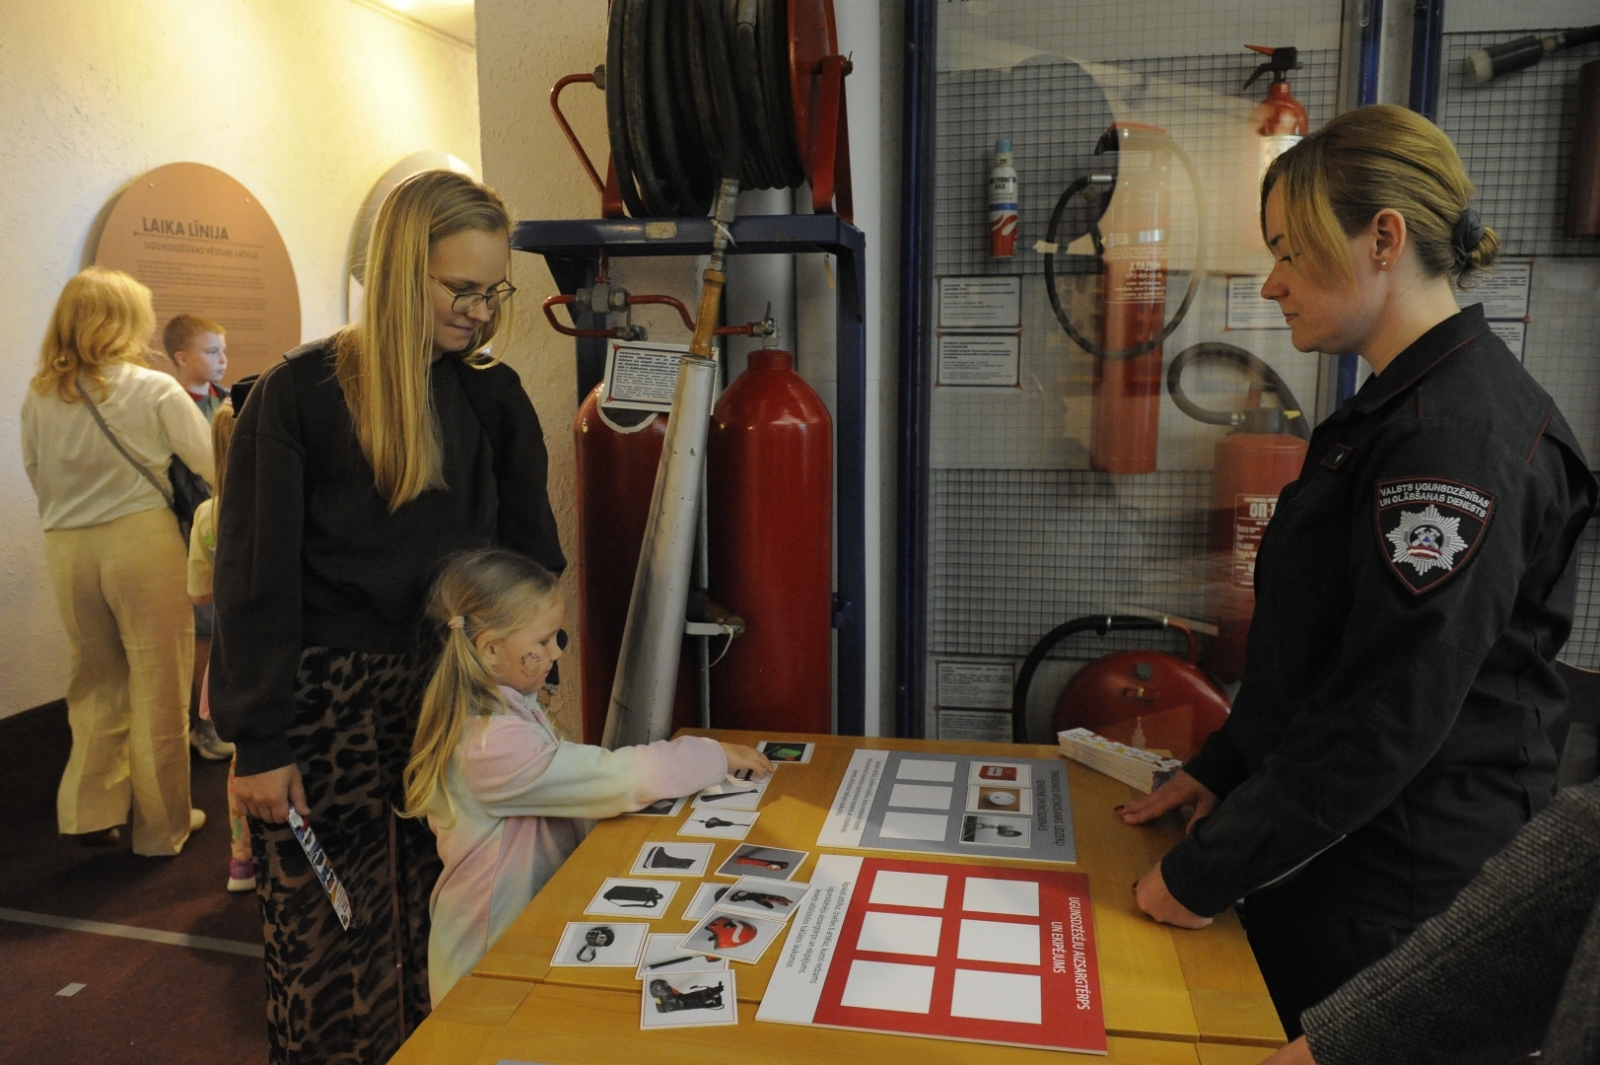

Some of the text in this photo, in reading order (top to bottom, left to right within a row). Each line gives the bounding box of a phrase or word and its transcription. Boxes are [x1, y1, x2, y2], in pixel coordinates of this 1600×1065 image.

[142, 218, 229, 240] LAIKA LĪNIJA
[1380, 483, 1490, 508] VALSTS UGUNSDZĒSĪBAS
[1380, 490, 1486, 518] UN GLĀBŠANAS DIENESTS
[818, 948, 828, 960] kuros
[1051, 921, 1066, 973] UN EKIPĒJUMS
[1069, 896, 1090, 1009] UGUNSDZĒSĒJU AIZSARGTĒRPS
